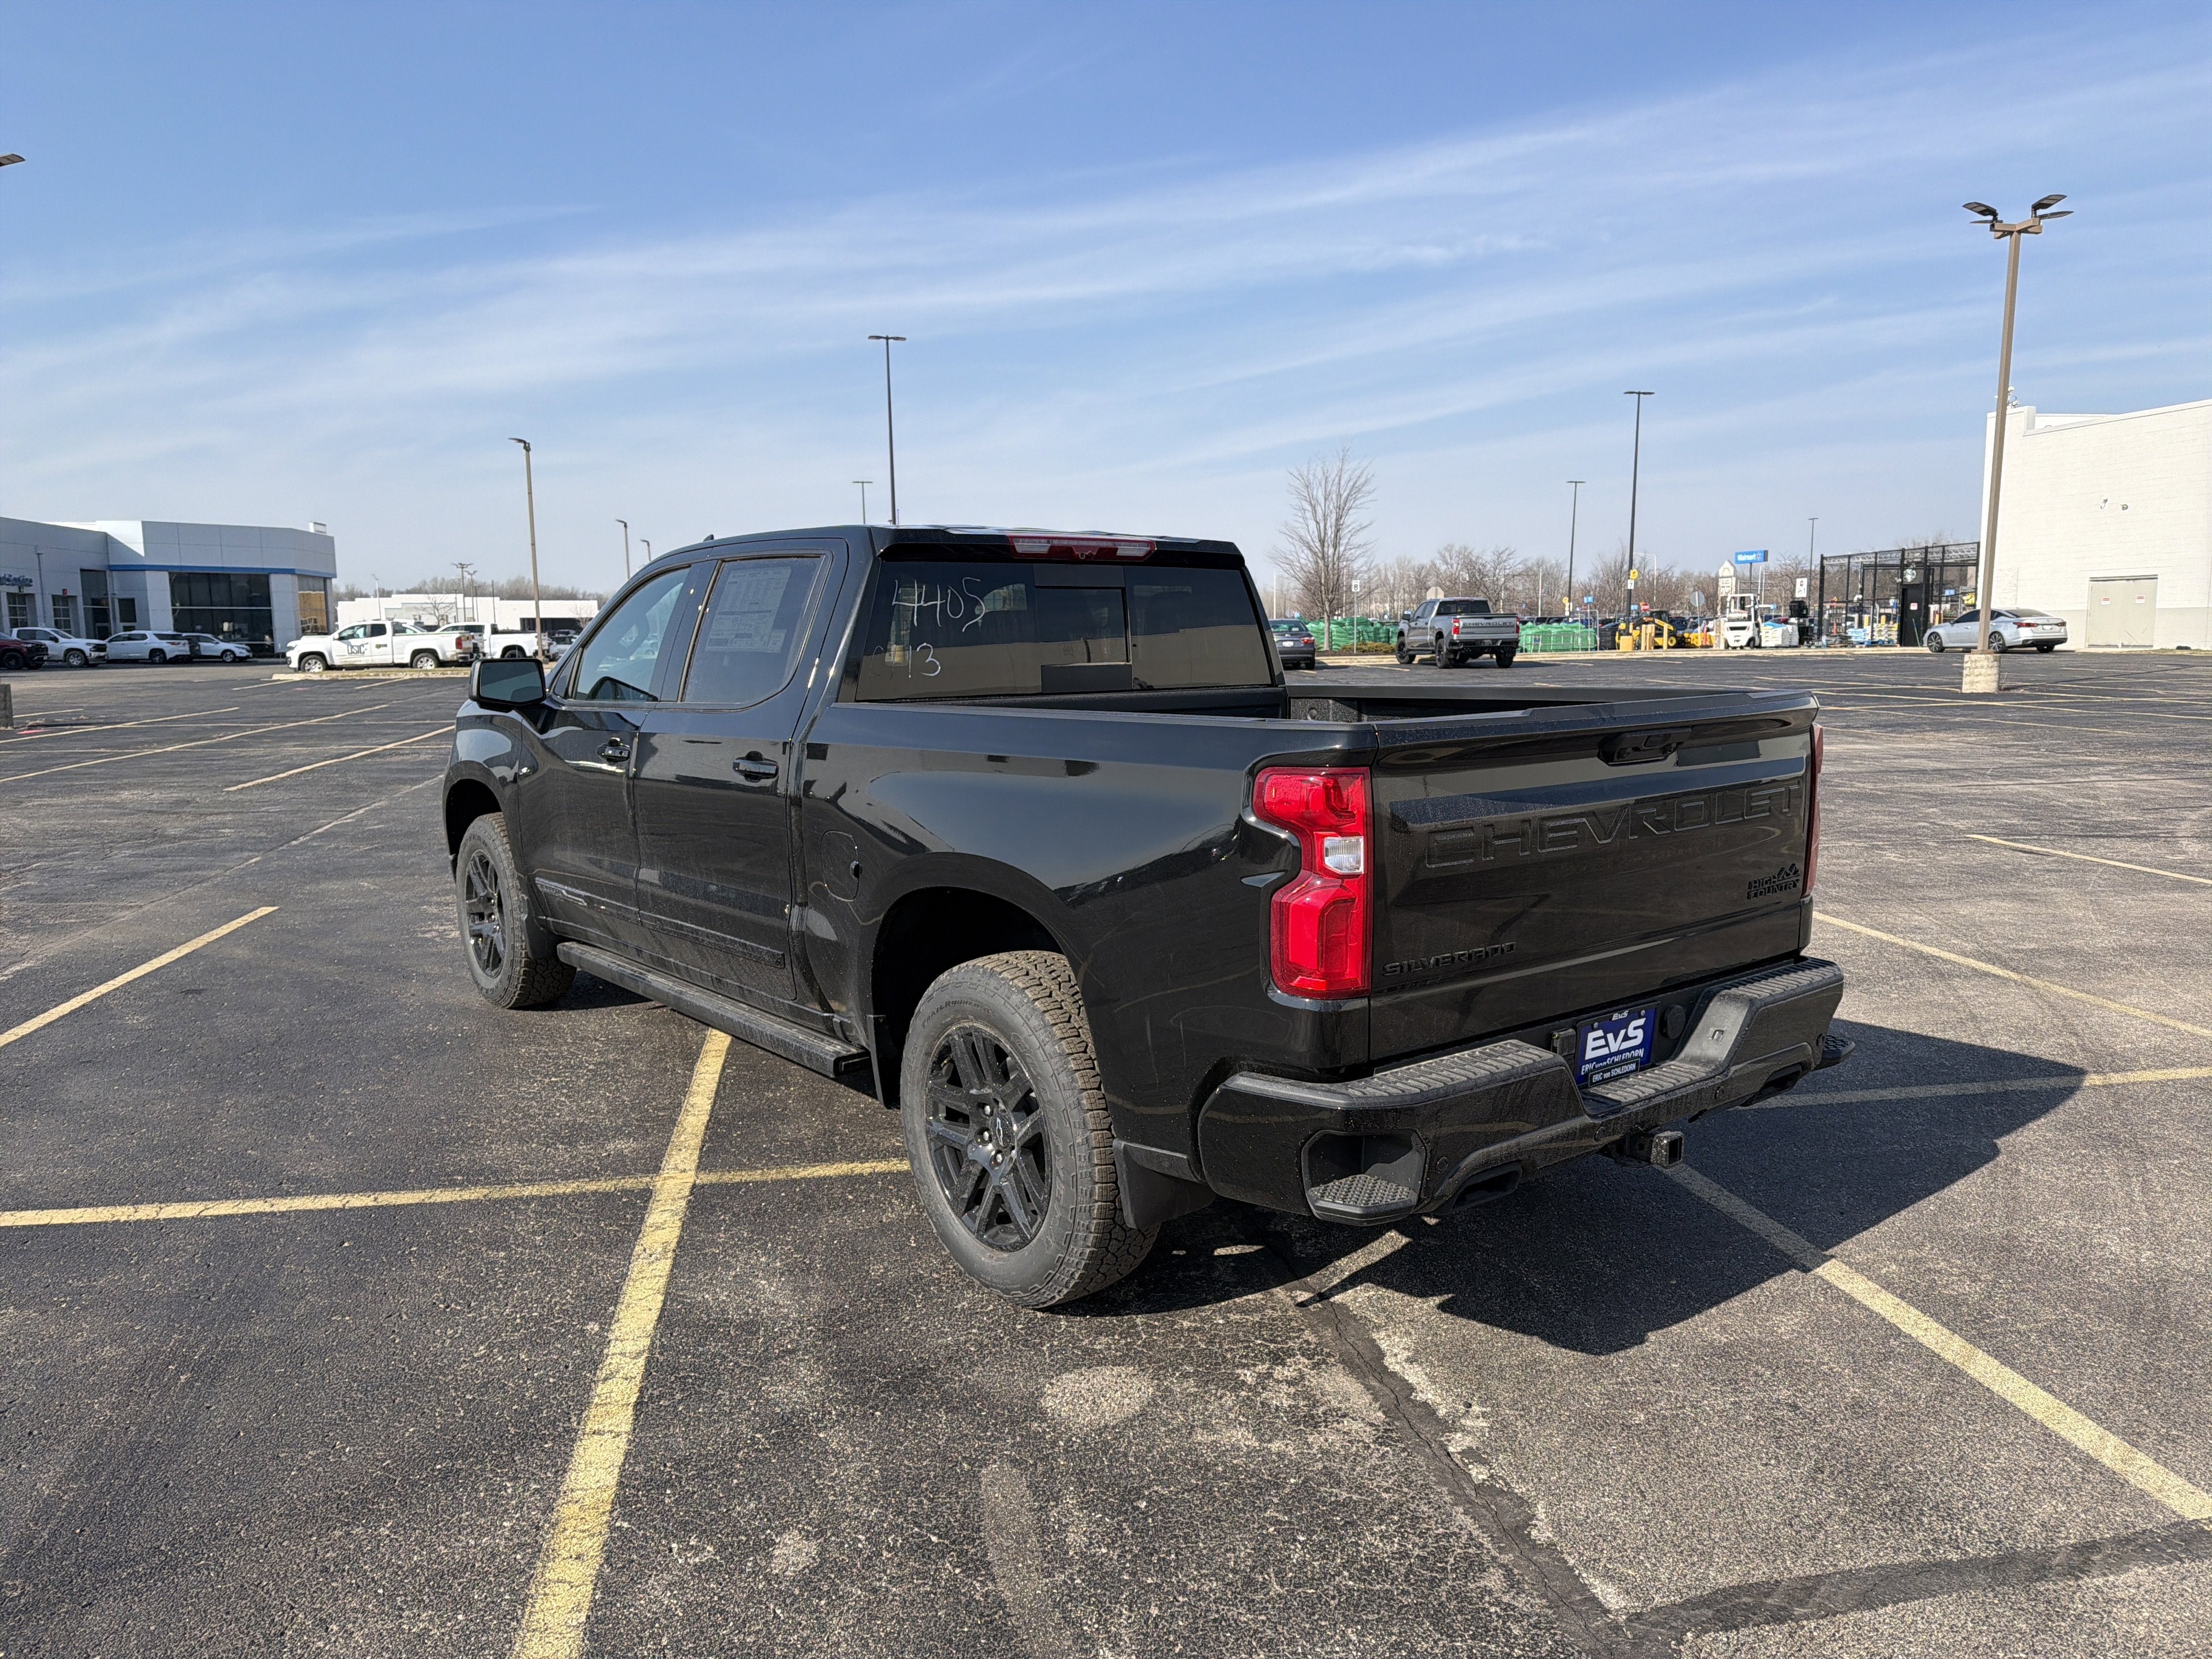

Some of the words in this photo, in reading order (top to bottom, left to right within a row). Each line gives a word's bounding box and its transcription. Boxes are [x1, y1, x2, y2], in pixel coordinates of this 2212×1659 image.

[1737, 552, 1756, 561] Walmart
[892, 577, 986, 632] 4405
[1425, 782, 1800, 868] CHEVROLET
[1747, 878, 1800, 900] COUNTRY
[1748, 875, 1778, 890] HIGH
[1383, 941, 1517, 976] SILVERADO
[1592, 1072, 1603, 1083] ERIC
[1611, 1063, 1637, 1077] SCHLEDORN
